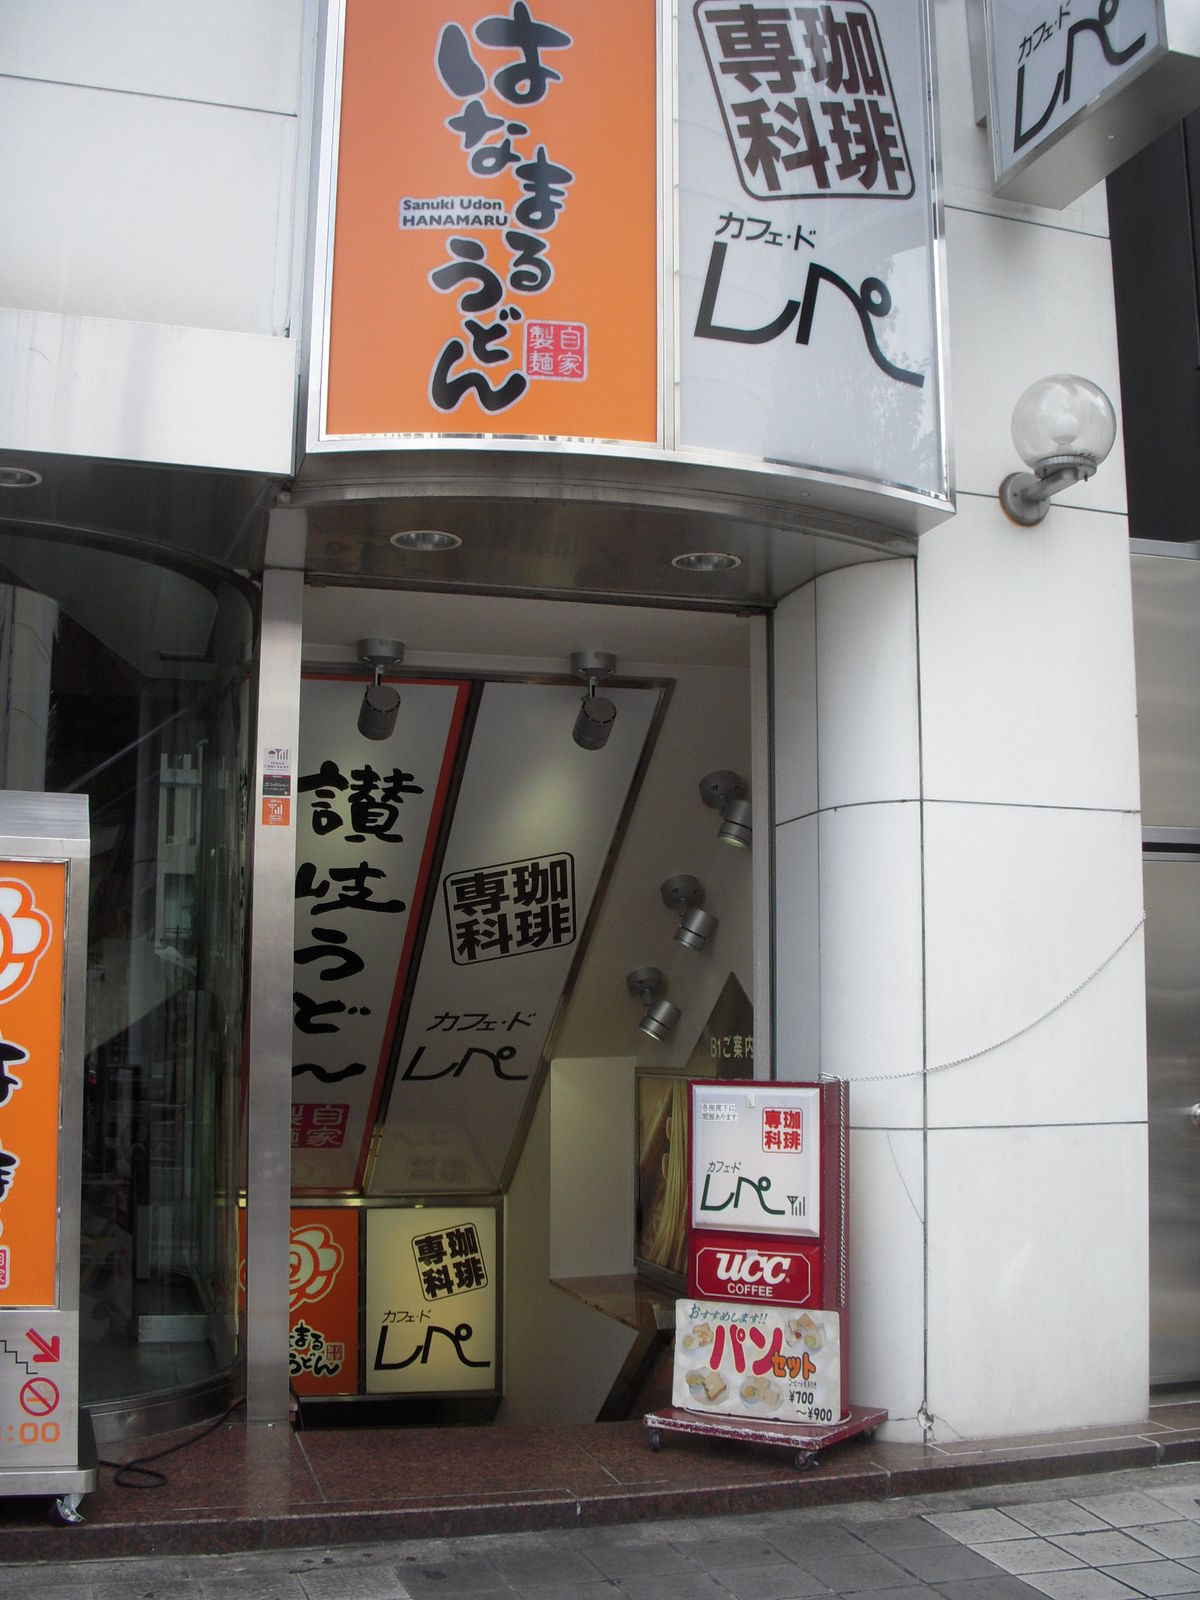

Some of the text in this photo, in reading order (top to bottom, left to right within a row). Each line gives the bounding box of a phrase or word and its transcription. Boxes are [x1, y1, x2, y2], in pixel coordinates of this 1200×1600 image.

[1013, 0, 1147, 153] レペ
[402, 199, 502, 211] Sanuki Udon
[402, 215, 508, 227] HANAMARU
[694, 241, 925, 388] レペ
[402, 1046, 529, 1081] レペ
[700, 1174, 786, 1215] レペ
[727, 1283, 774, 1297] COFFEE
[374, 1323, 491, 1371] レペ
[789, 1390, 814, 1405] ¥700
